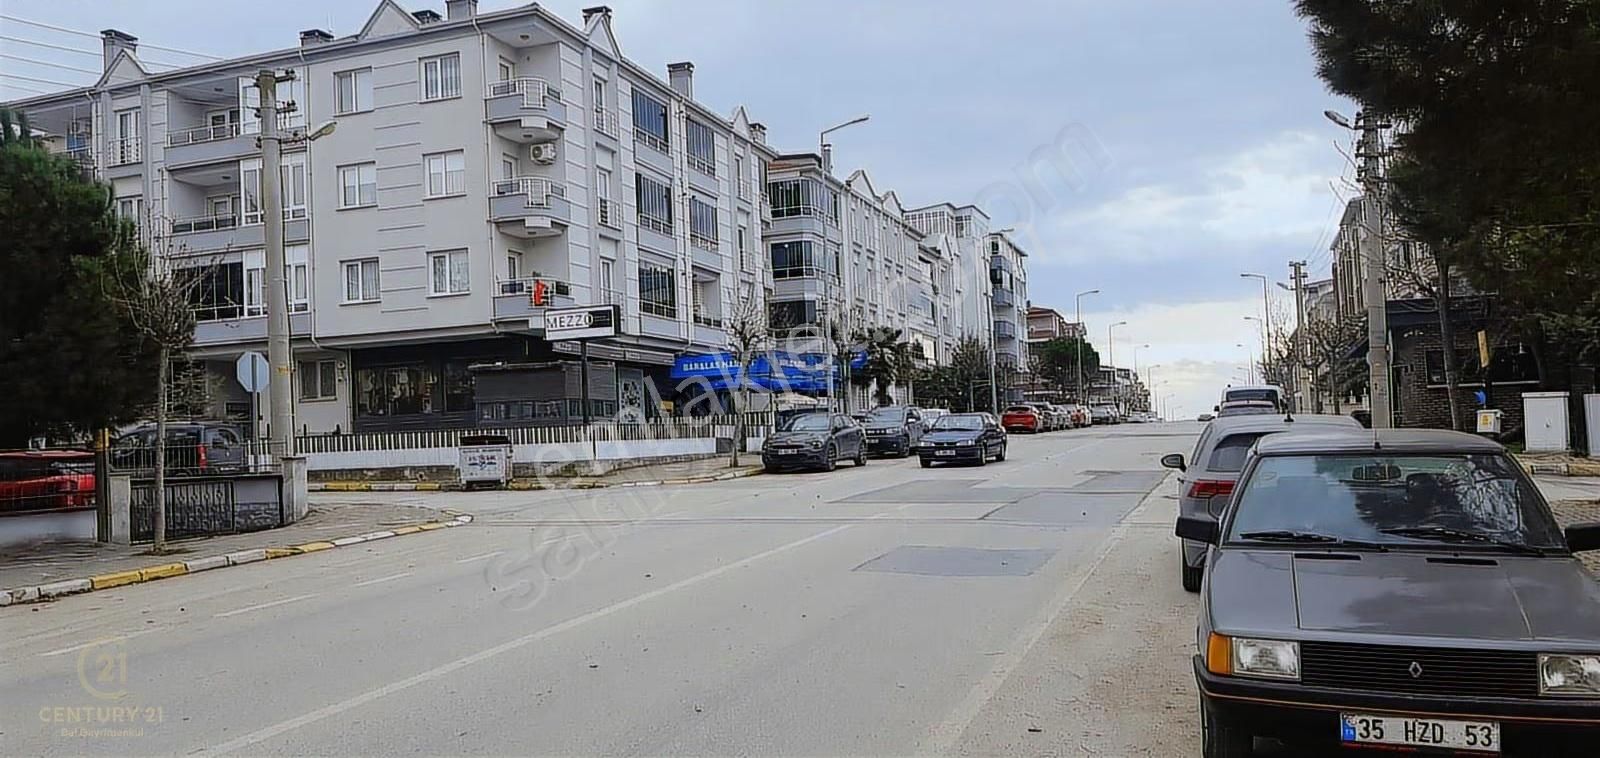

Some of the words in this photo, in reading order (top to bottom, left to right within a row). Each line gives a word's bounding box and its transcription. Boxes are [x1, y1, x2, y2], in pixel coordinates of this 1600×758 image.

[546, 313, 594, 329] MEZZO
[1358, 718, 1384, 740] 35
[1404, 720, 1444, 744] HZD
[1465, 724, 1493, 747] 53
